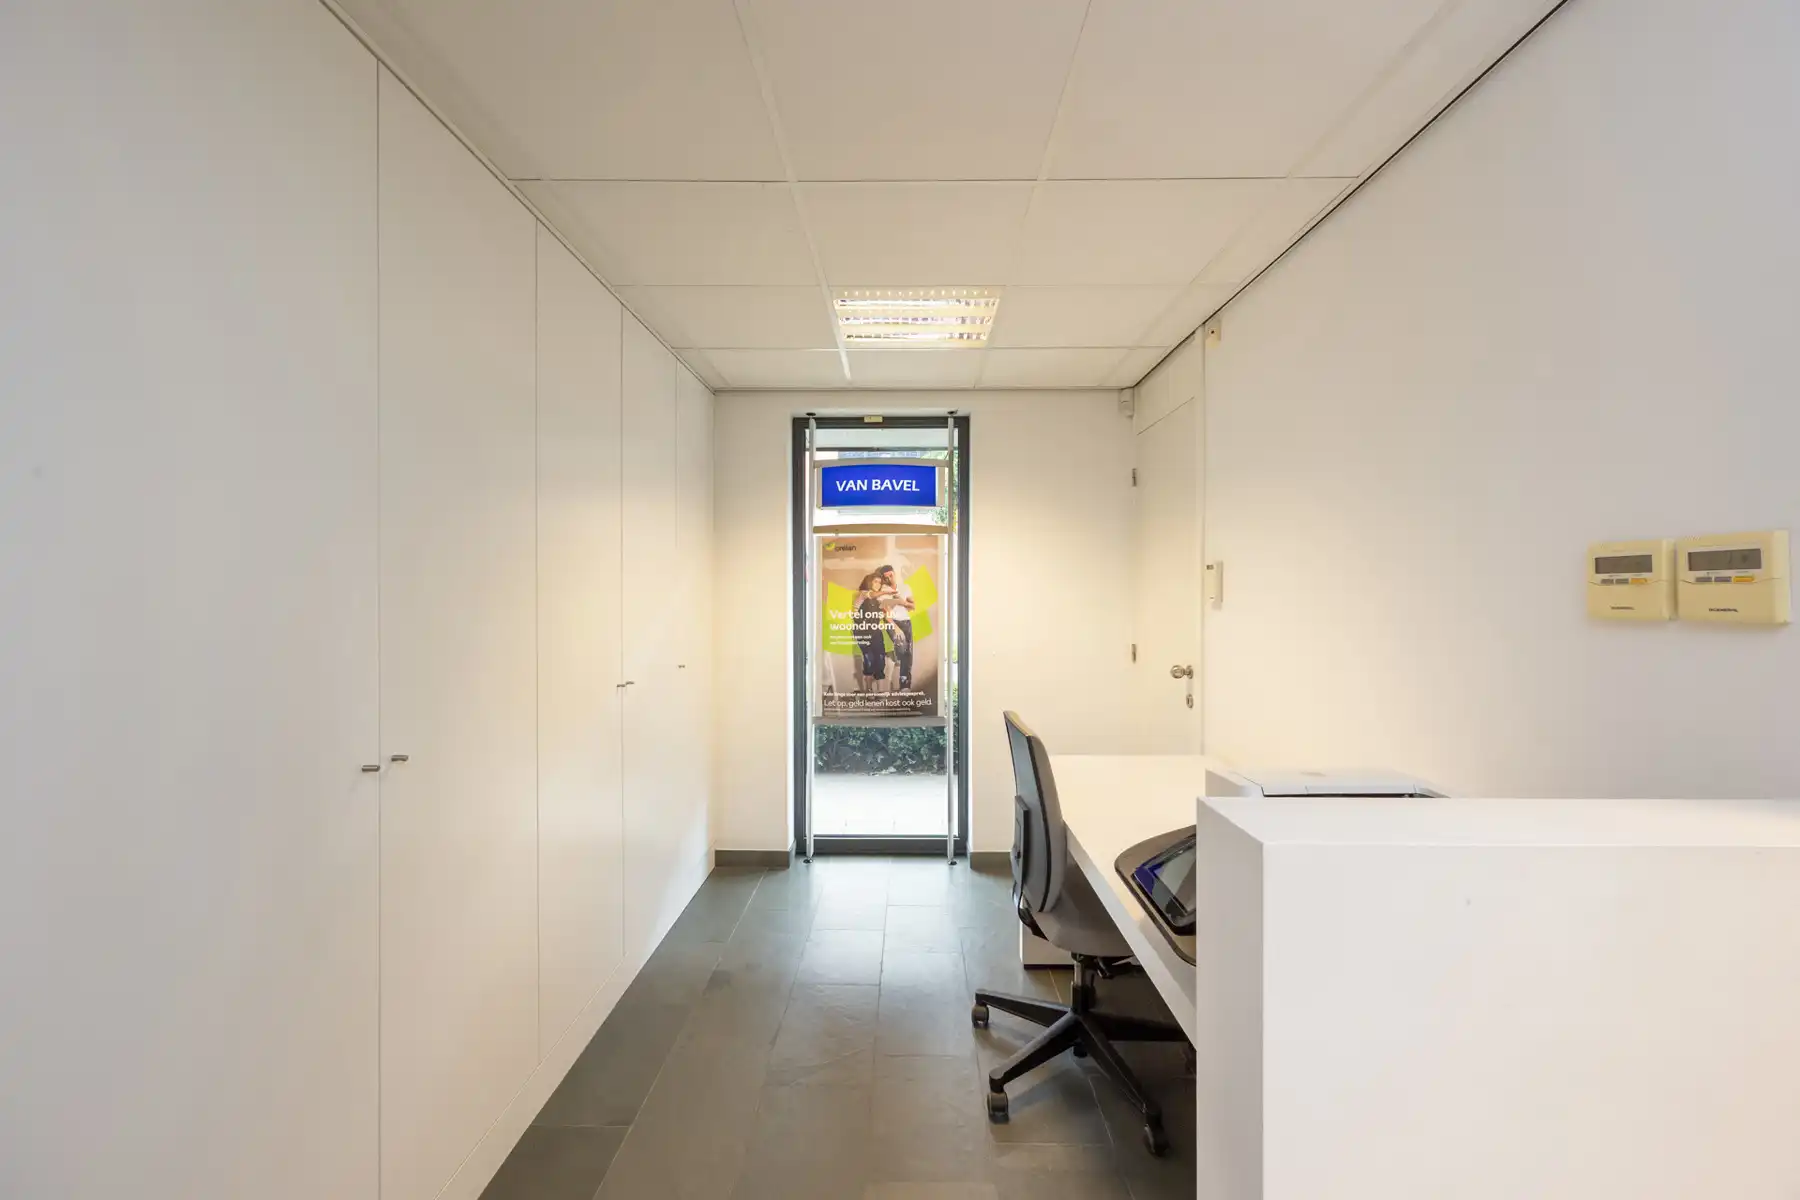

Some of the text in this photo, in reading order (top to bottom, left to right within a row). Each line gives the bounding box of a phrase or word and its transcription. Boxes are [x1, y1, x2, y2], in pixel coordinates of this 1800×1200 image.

[836, 479, 920, 492] VAN BAVEL
[829, 609, 863, 619] Vertel
[865, 611, 884, 619] ons
[848, 700, 864, 708] geld
[865, 699, 884, 707] lenen
[885, 699, 901, 707] kost
[901, 699, 915, 707] ook
